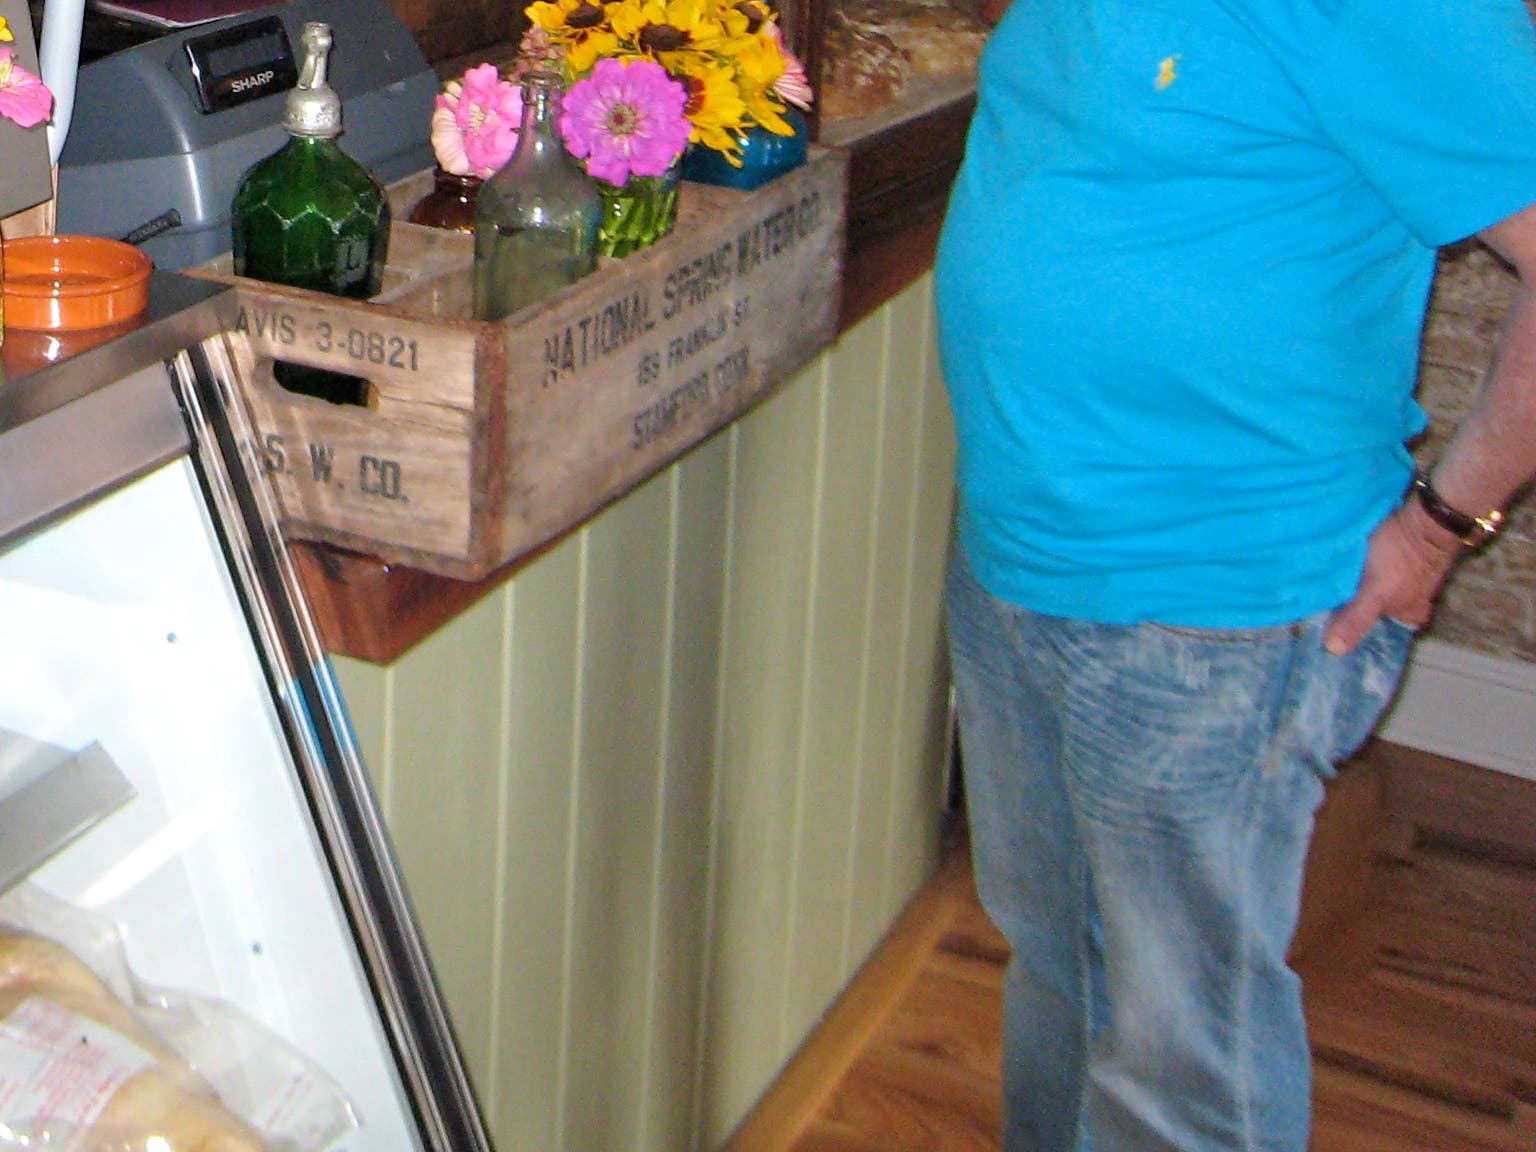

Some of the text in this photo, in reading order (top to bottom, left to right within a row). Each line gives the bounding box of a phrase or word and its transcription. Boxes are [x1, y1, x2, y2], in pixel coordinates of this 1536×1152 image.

[231, 70, 274, 94] SHARP
[543, 289, 655, 386] NATIONAL
[663, 240, 732, 320] SPRING
[315, 321, 419, 371] 3-0821
[360, 454, 409, 505] CO.
